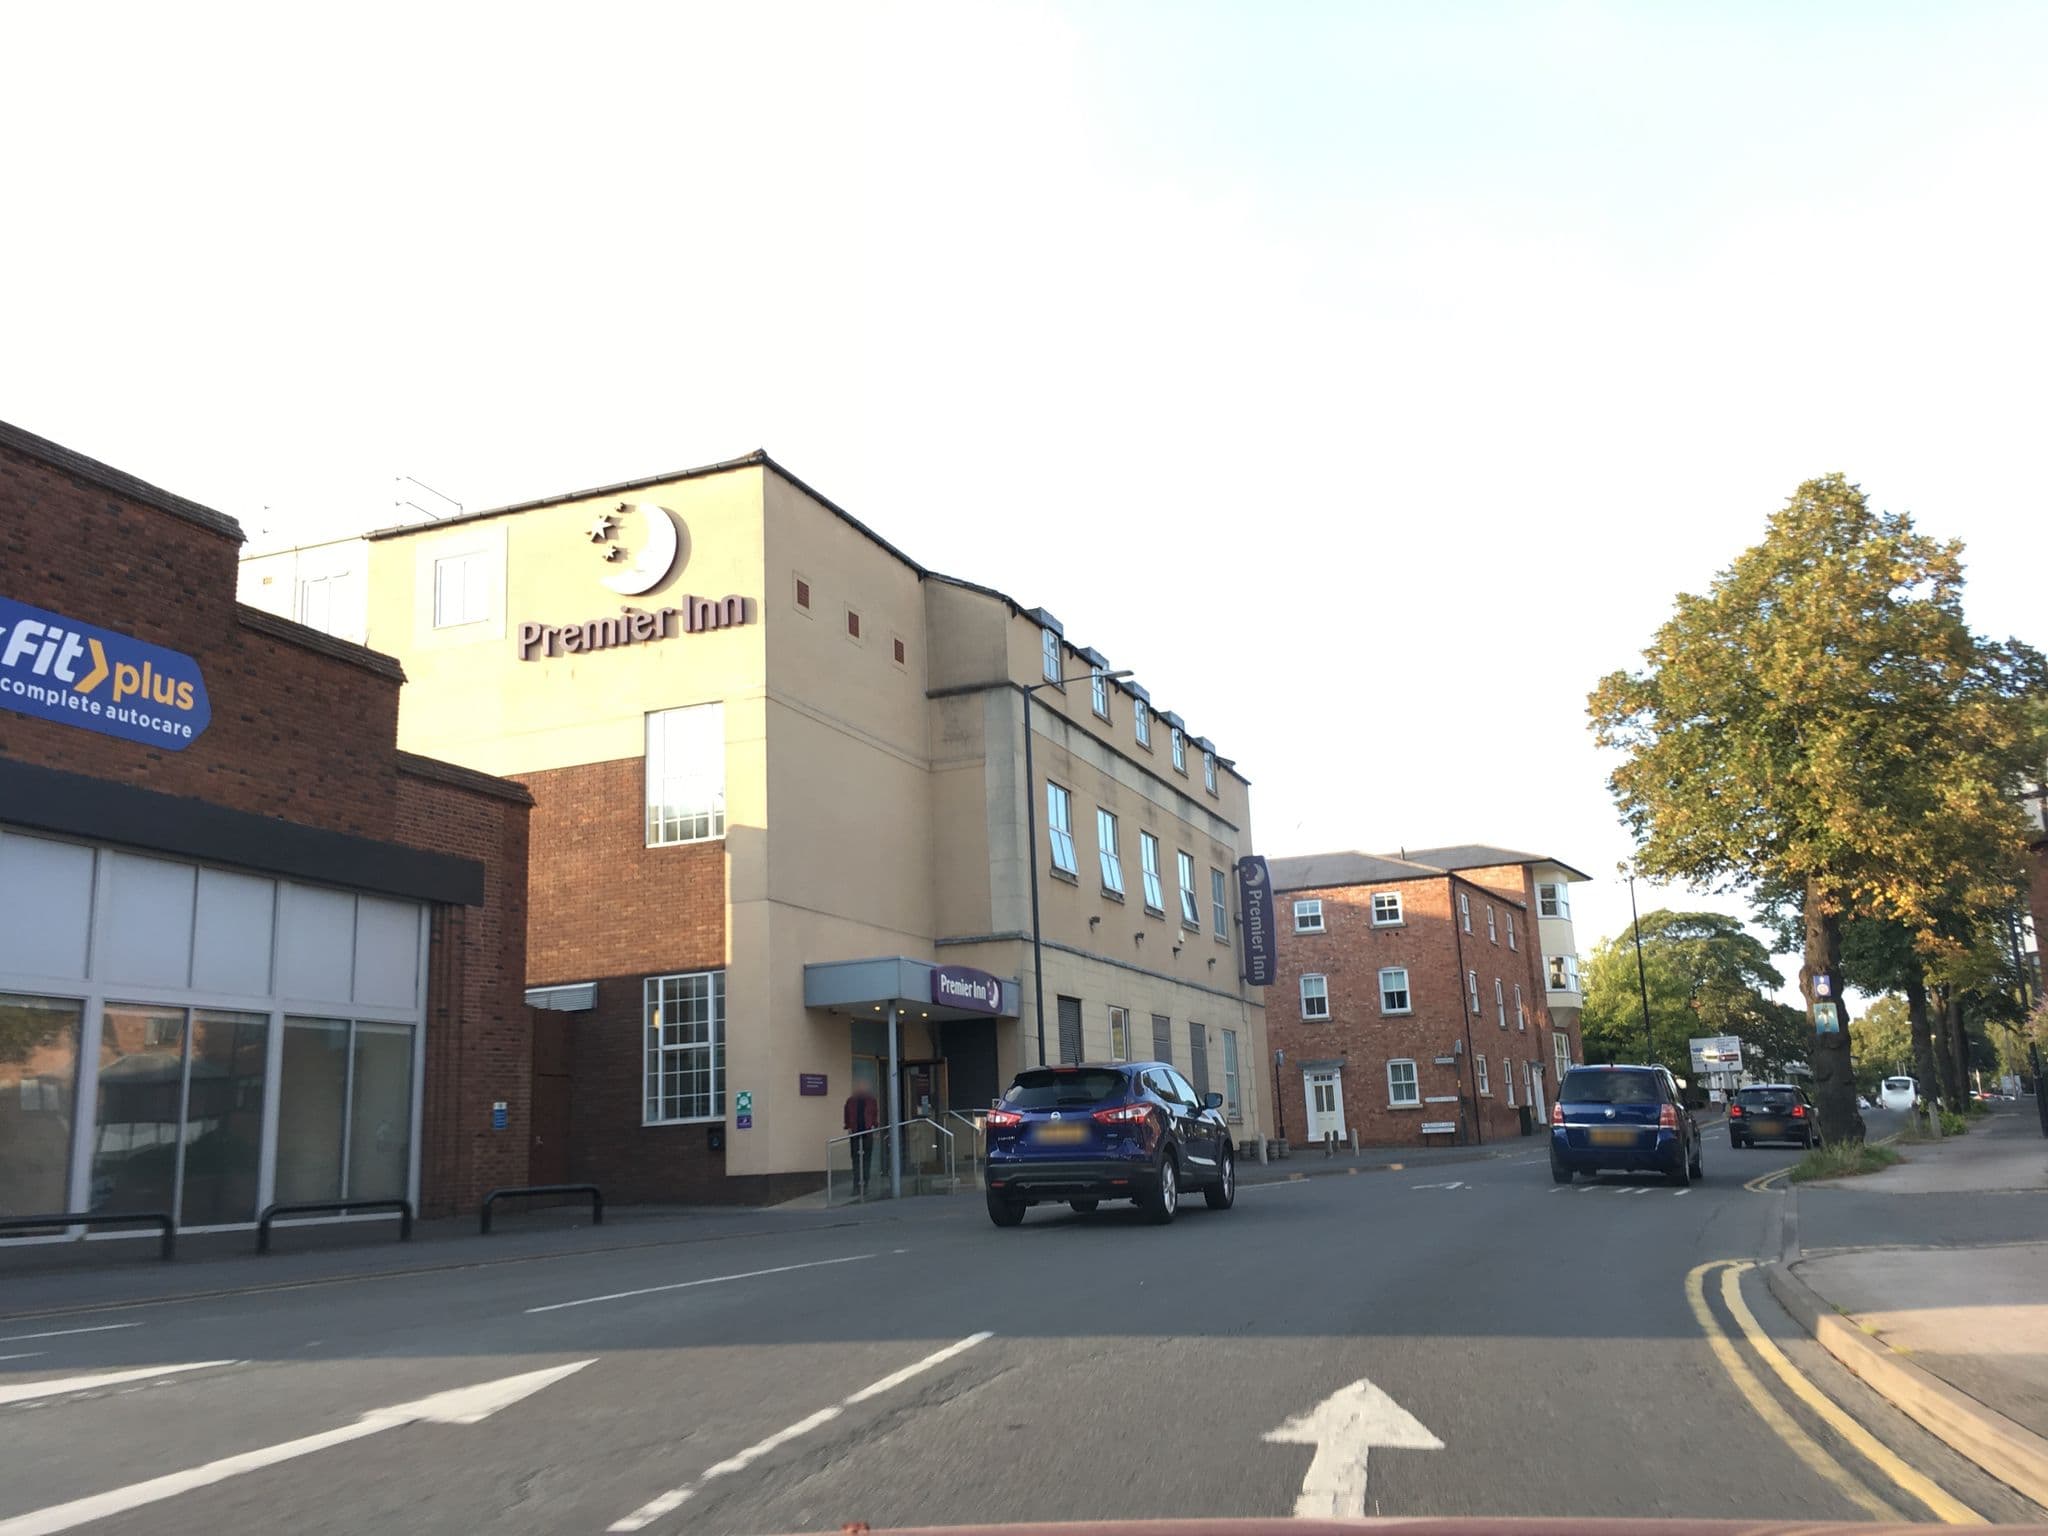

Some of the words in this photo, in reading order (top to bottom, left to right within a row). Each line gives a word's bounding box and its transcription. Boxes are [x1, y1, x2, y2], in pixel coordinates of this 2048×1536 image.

[518, 605, 675, 661] Premier
[683, 594, 747, 634] Inn
[0, 677, 101, 715] complete
[105, 705, 192, 738] autocare
[112, 661, 194, 711] plus
[1248, 889, 1265, 952] Premier
[940, 974, 972, 999] Premier
[973, 981, 986, 1000] Inn
[1253, 955, 1266, 980] Inn
